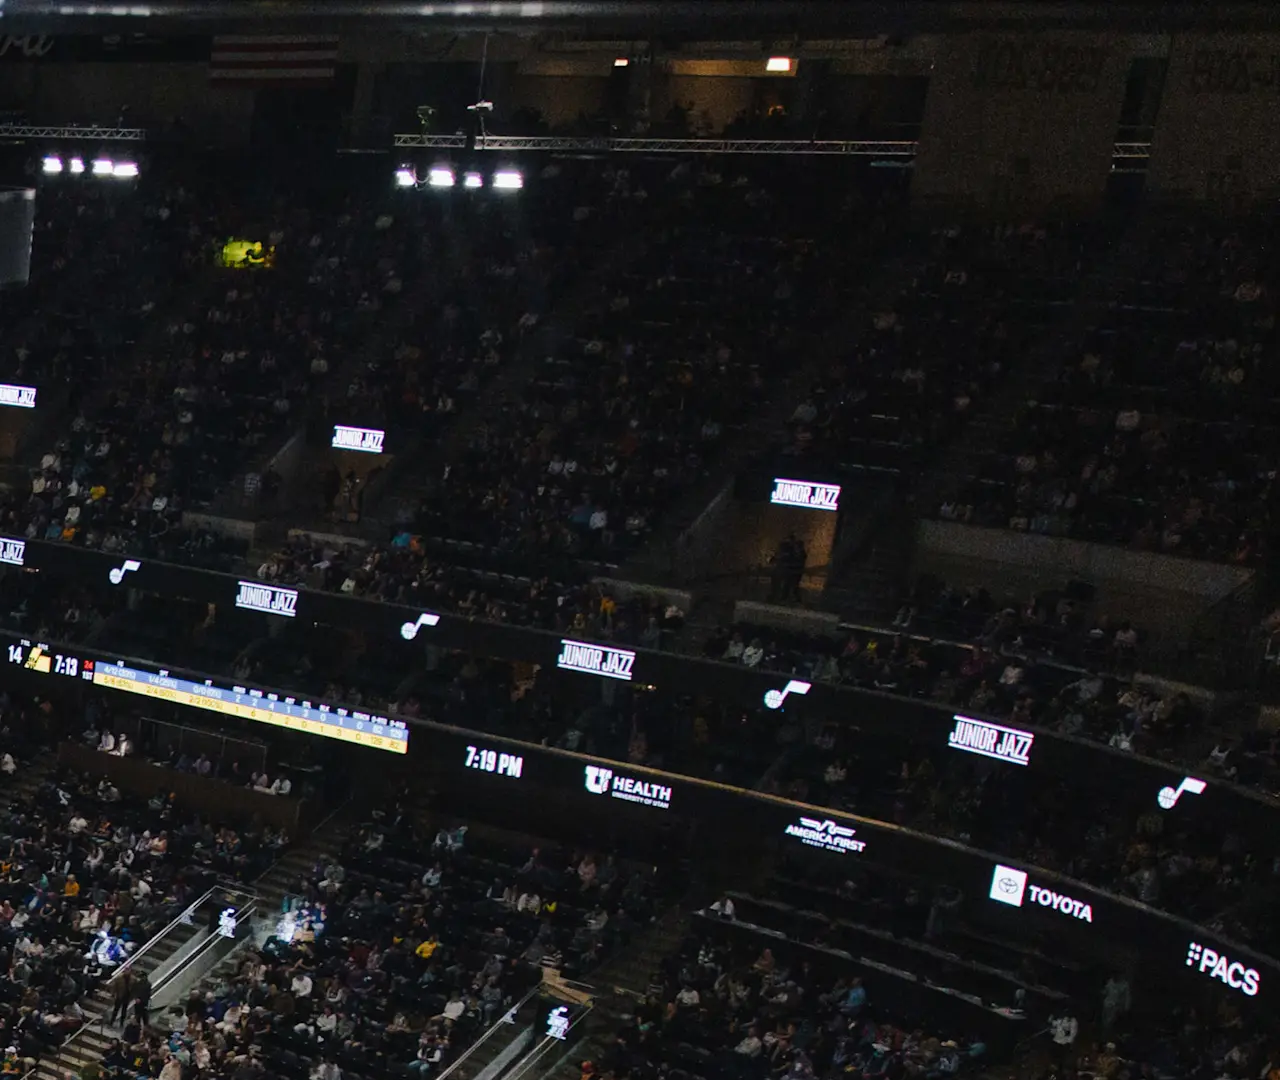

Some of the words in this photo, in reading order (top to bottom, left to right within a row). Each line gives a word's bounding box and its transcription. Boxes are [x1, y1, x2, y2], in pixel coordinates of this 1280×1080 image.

[333, 430, 361, 446] JUNIOR
[362, 434, 384, 450] JAZZ
[772, 482, 808, 503] JUNIOR
[810, 487, 839, 506] JAZZ
[5, 543, 24, 561] JAZZ
[237, 585, 269, 608] JUNIOR
[272, 591, 297, 613] JAZZ
[8, 646, 22, 663] 14
[55, 655, 77, 676] 7:13
[84, 660, 94, 668] 24
[558, 644, 602, 669] JUNIOR
[603, 650, 633, 676] JAZZ
[82, 671, 93, 680] 1ST
[950, 720, 995, 751] JUNIOR
[997, 731, 1032, 760] JAZZ
[465, 746, 496, 772] 7:19
[498, 753, 523, 778] PM
[613, 776, 672, 801] HEALTH
[785, 825, 832, 844] AMERICA
[833, 837, 865, 852] FIRST
[1029, 885, 1092, 922] TOYOTA
[1200, 948, 1260, 996] PACS
